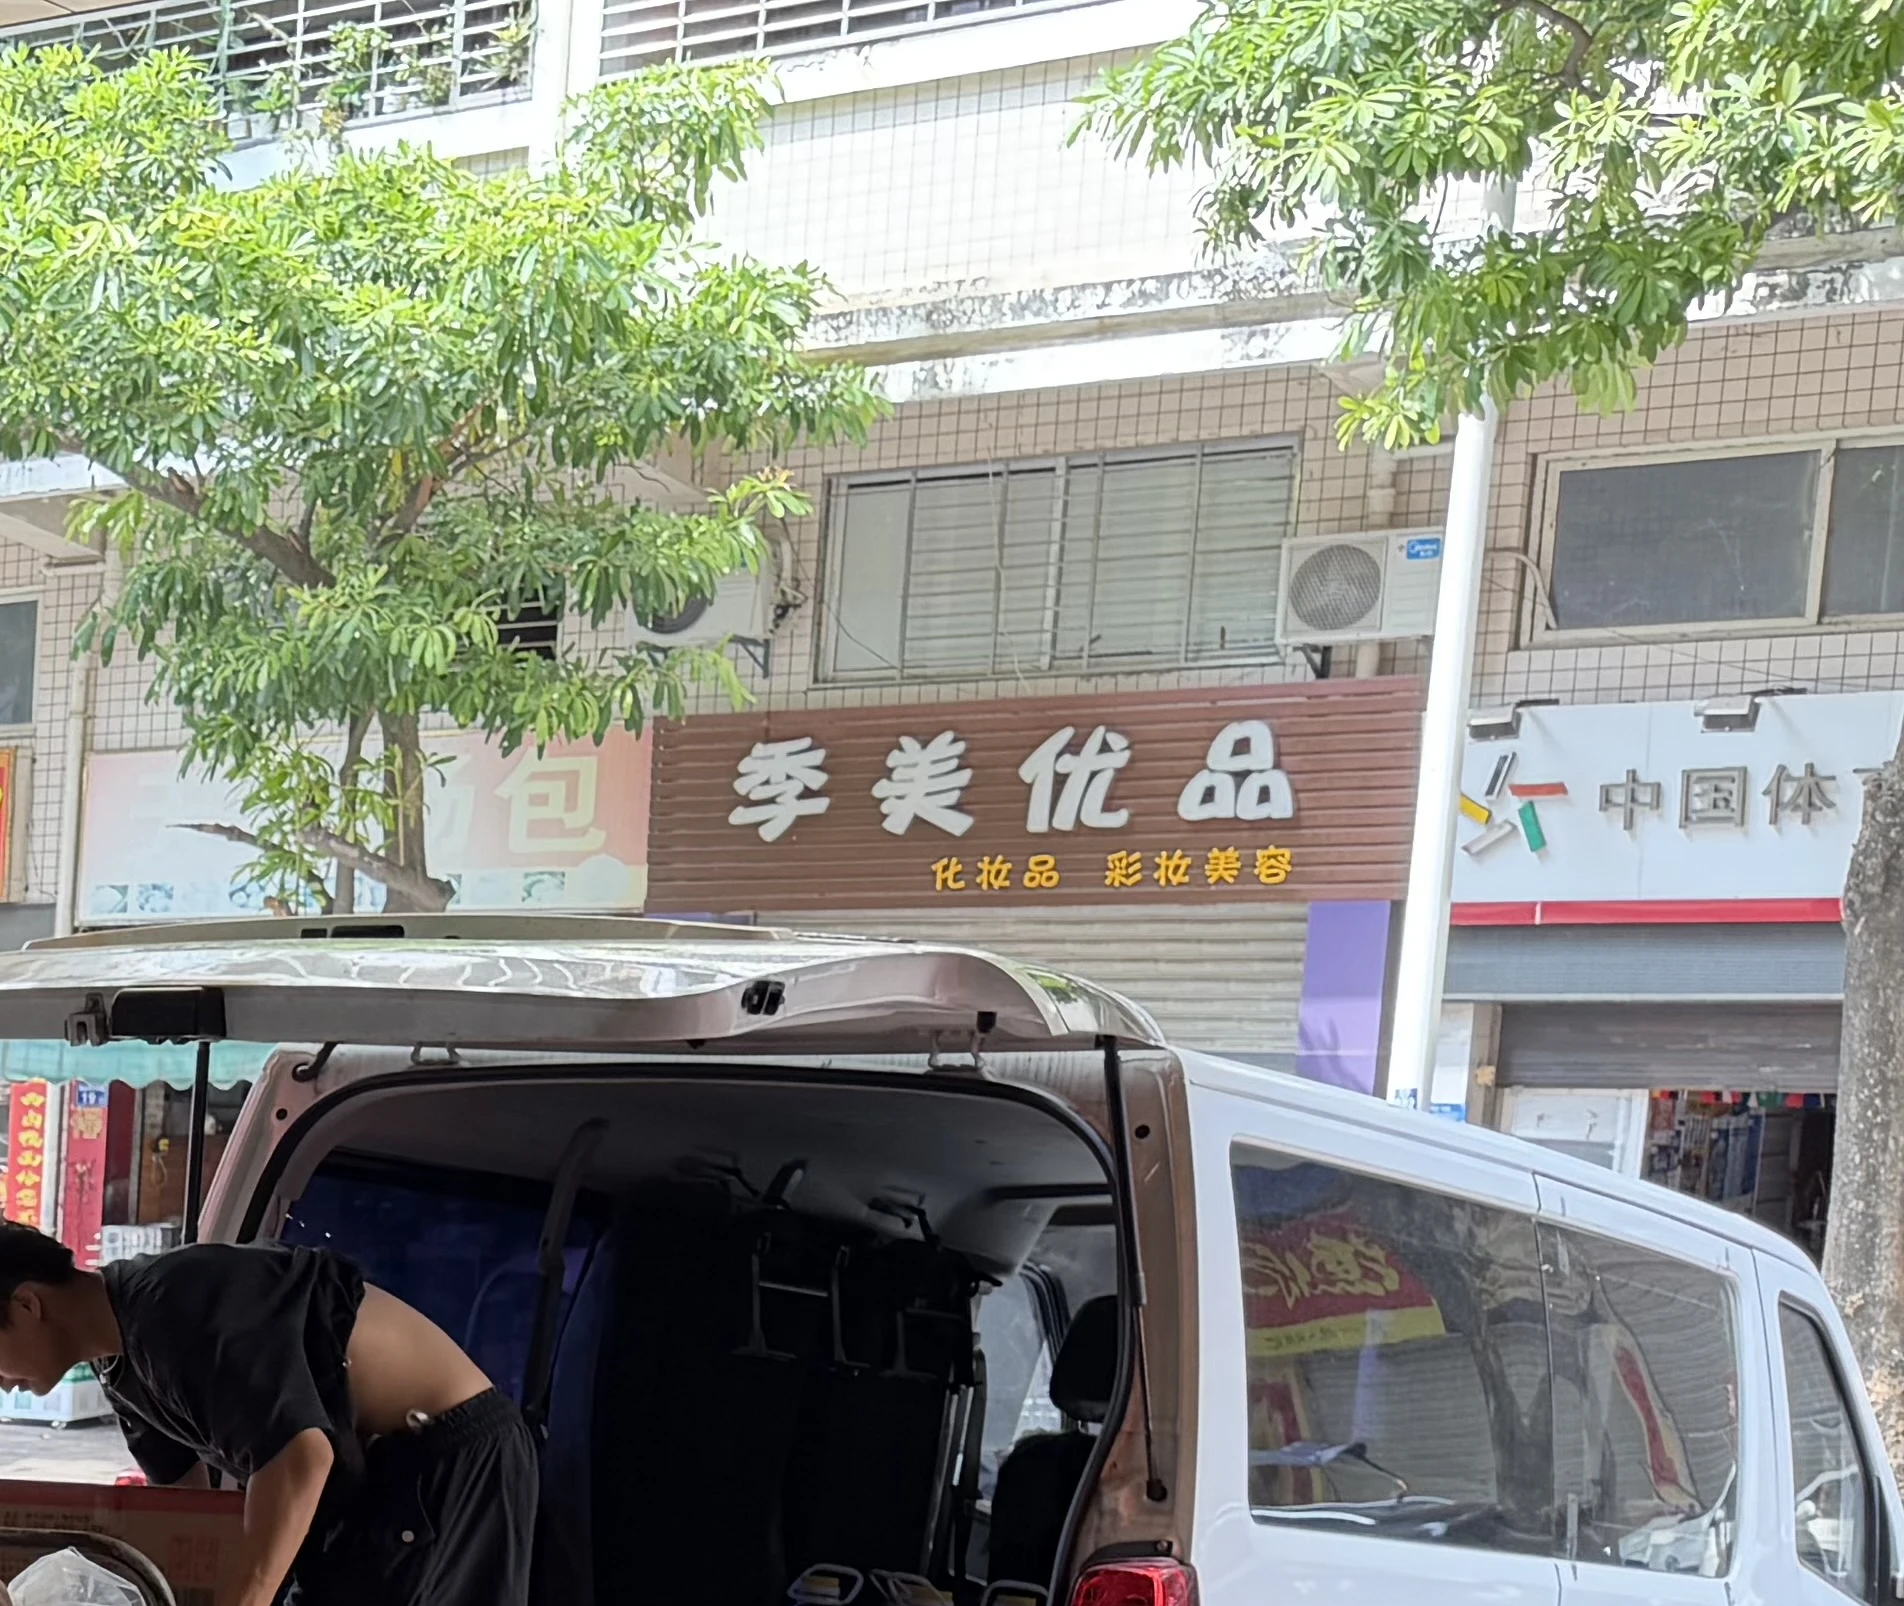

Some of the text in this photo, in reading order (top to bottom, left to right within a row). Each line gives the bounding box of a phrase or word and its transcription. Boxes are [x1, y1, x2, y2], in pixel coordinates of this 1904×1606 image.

[728, 719, 1295, 842] 季美优品
[931, 846, 1294, 891] 化妆品 彩妆美容
